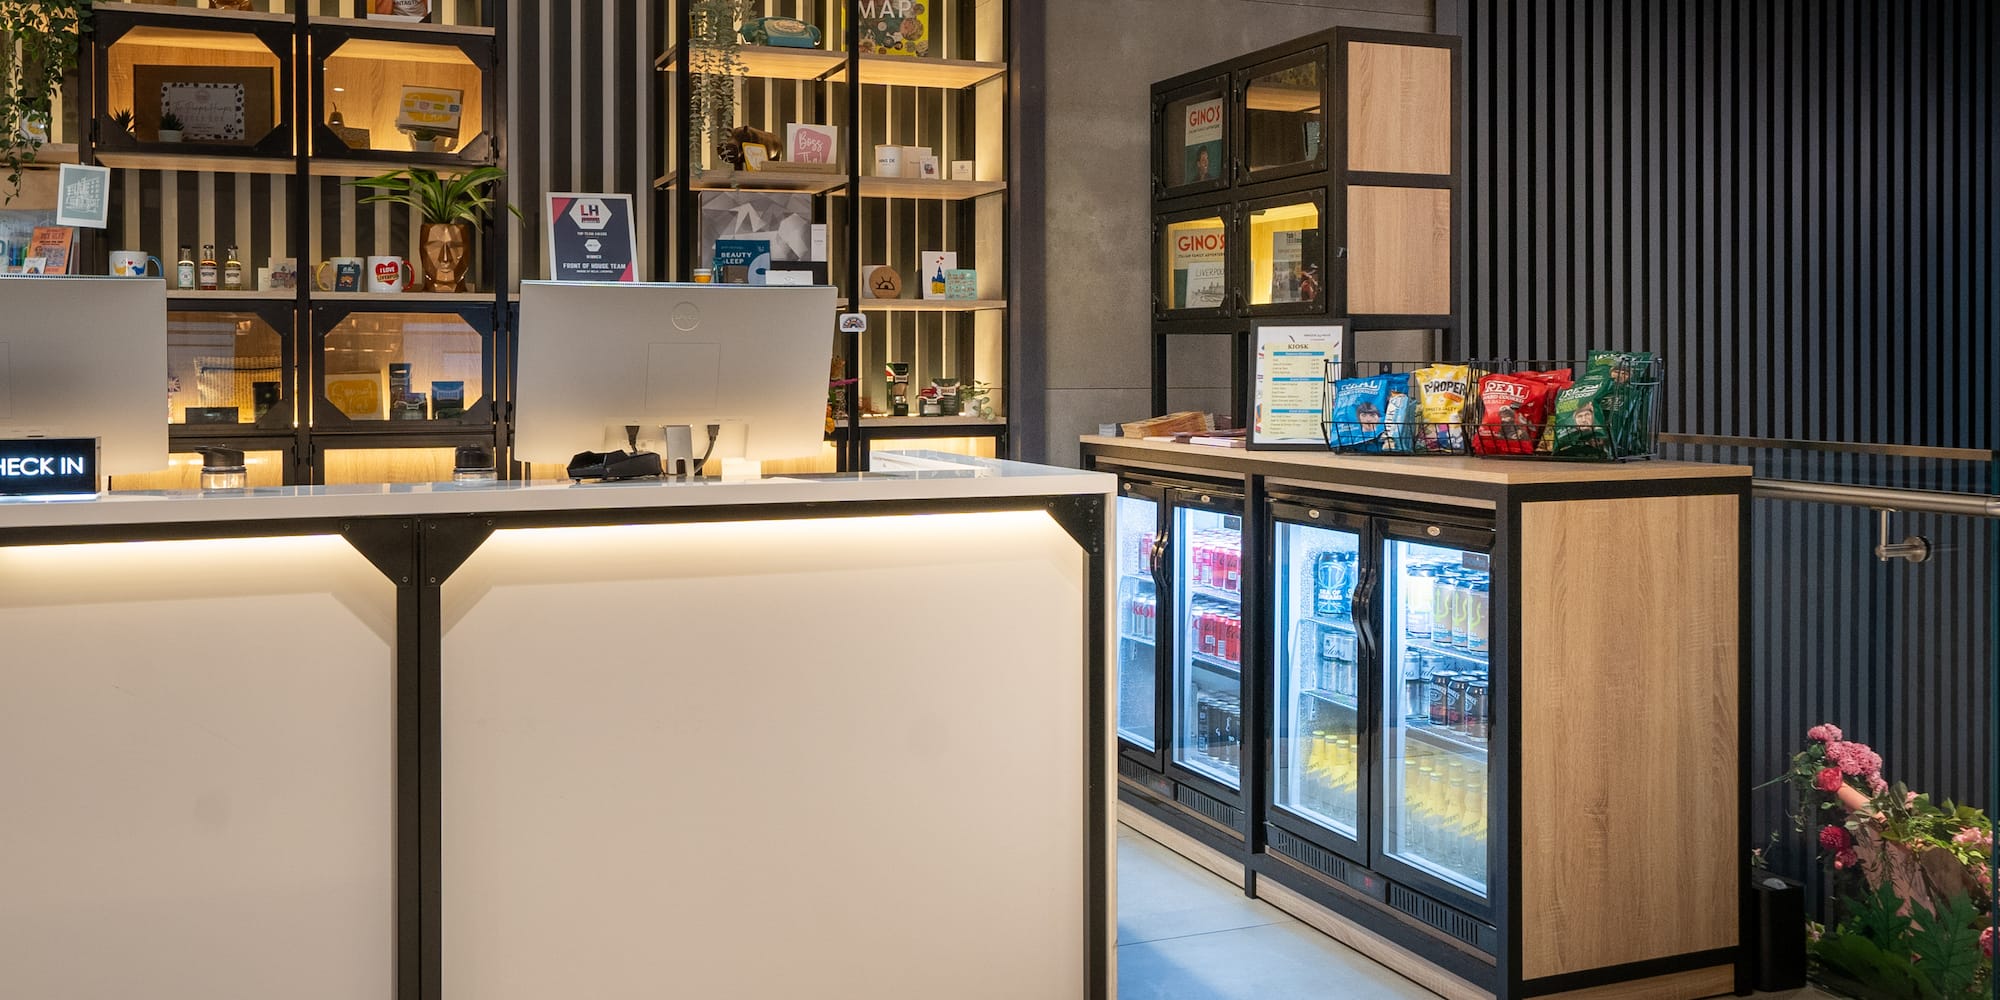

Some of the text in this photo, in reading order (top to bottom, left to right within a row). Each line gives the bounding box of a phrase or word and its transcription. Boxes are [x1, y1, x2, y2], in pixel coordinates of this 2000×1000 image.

[858, 0, 911, 18] MAP
[1190, 105, 1220, 126] GINO'S
[799, 131, 824, 153] Boss
[580, 204, 599, 216] LH
[1178, 234, 1225, 251] GINO'S
[1485, 382, 1525, 399] REAL
[60, 456, 84, 475] IN
